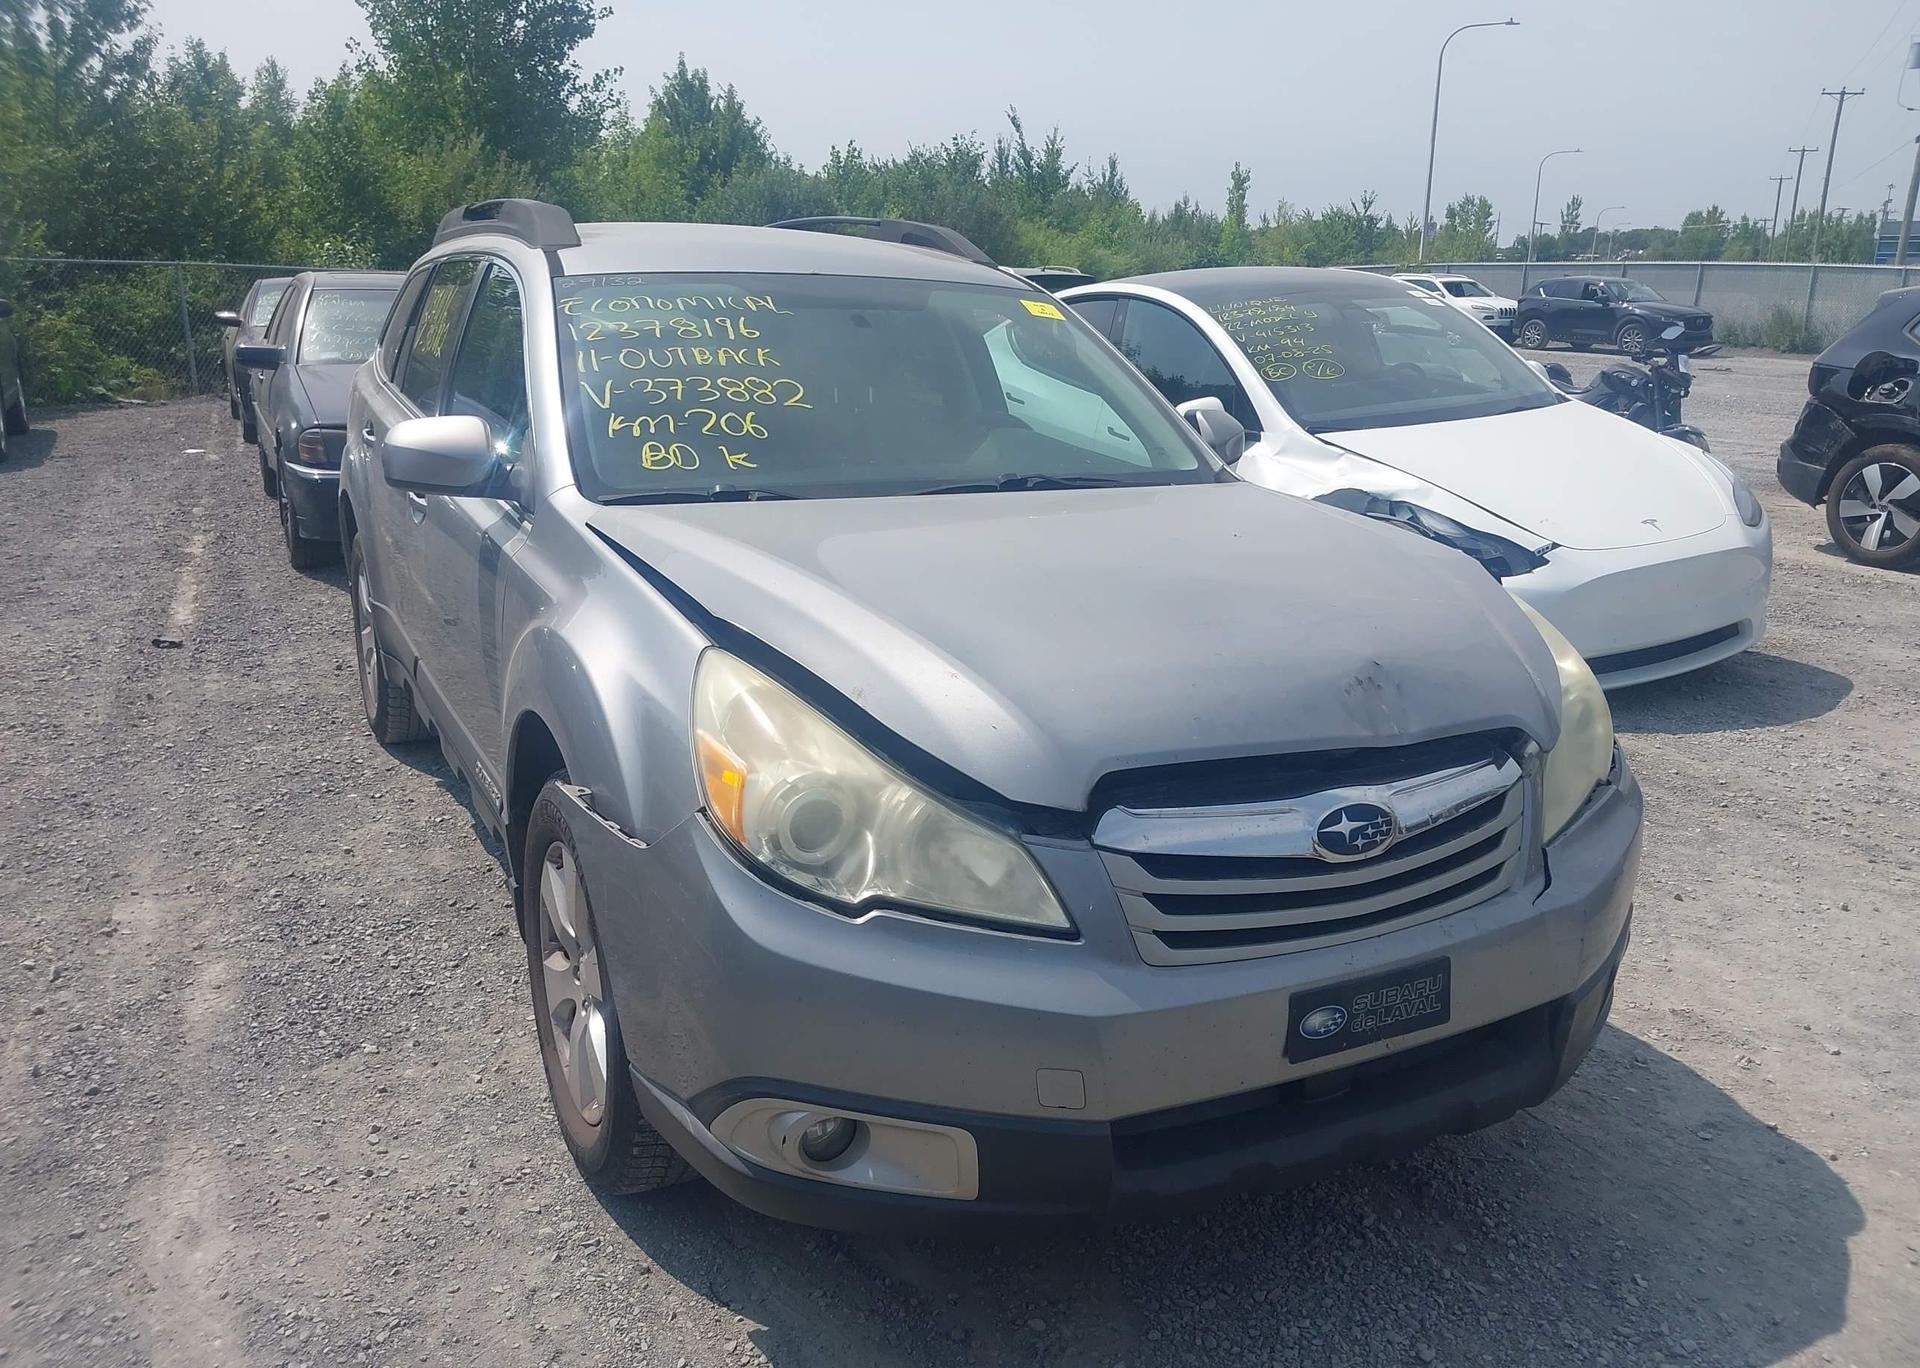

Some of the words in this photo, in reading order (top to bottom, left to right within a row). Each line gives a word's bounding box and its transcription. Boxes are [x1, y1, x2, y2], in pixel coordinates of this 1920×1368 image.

[558, 295, 795, 316] ECONOMICAL
[567, 316, 760, 341] 12378196
[577, 346, 781, 372] 11-OUTBACK
[580, 376, 814, 409] V-373882
[1352, 974, 1443, 1014] SUBARU
[1376, 994, 1441, 1027] LAVAL
